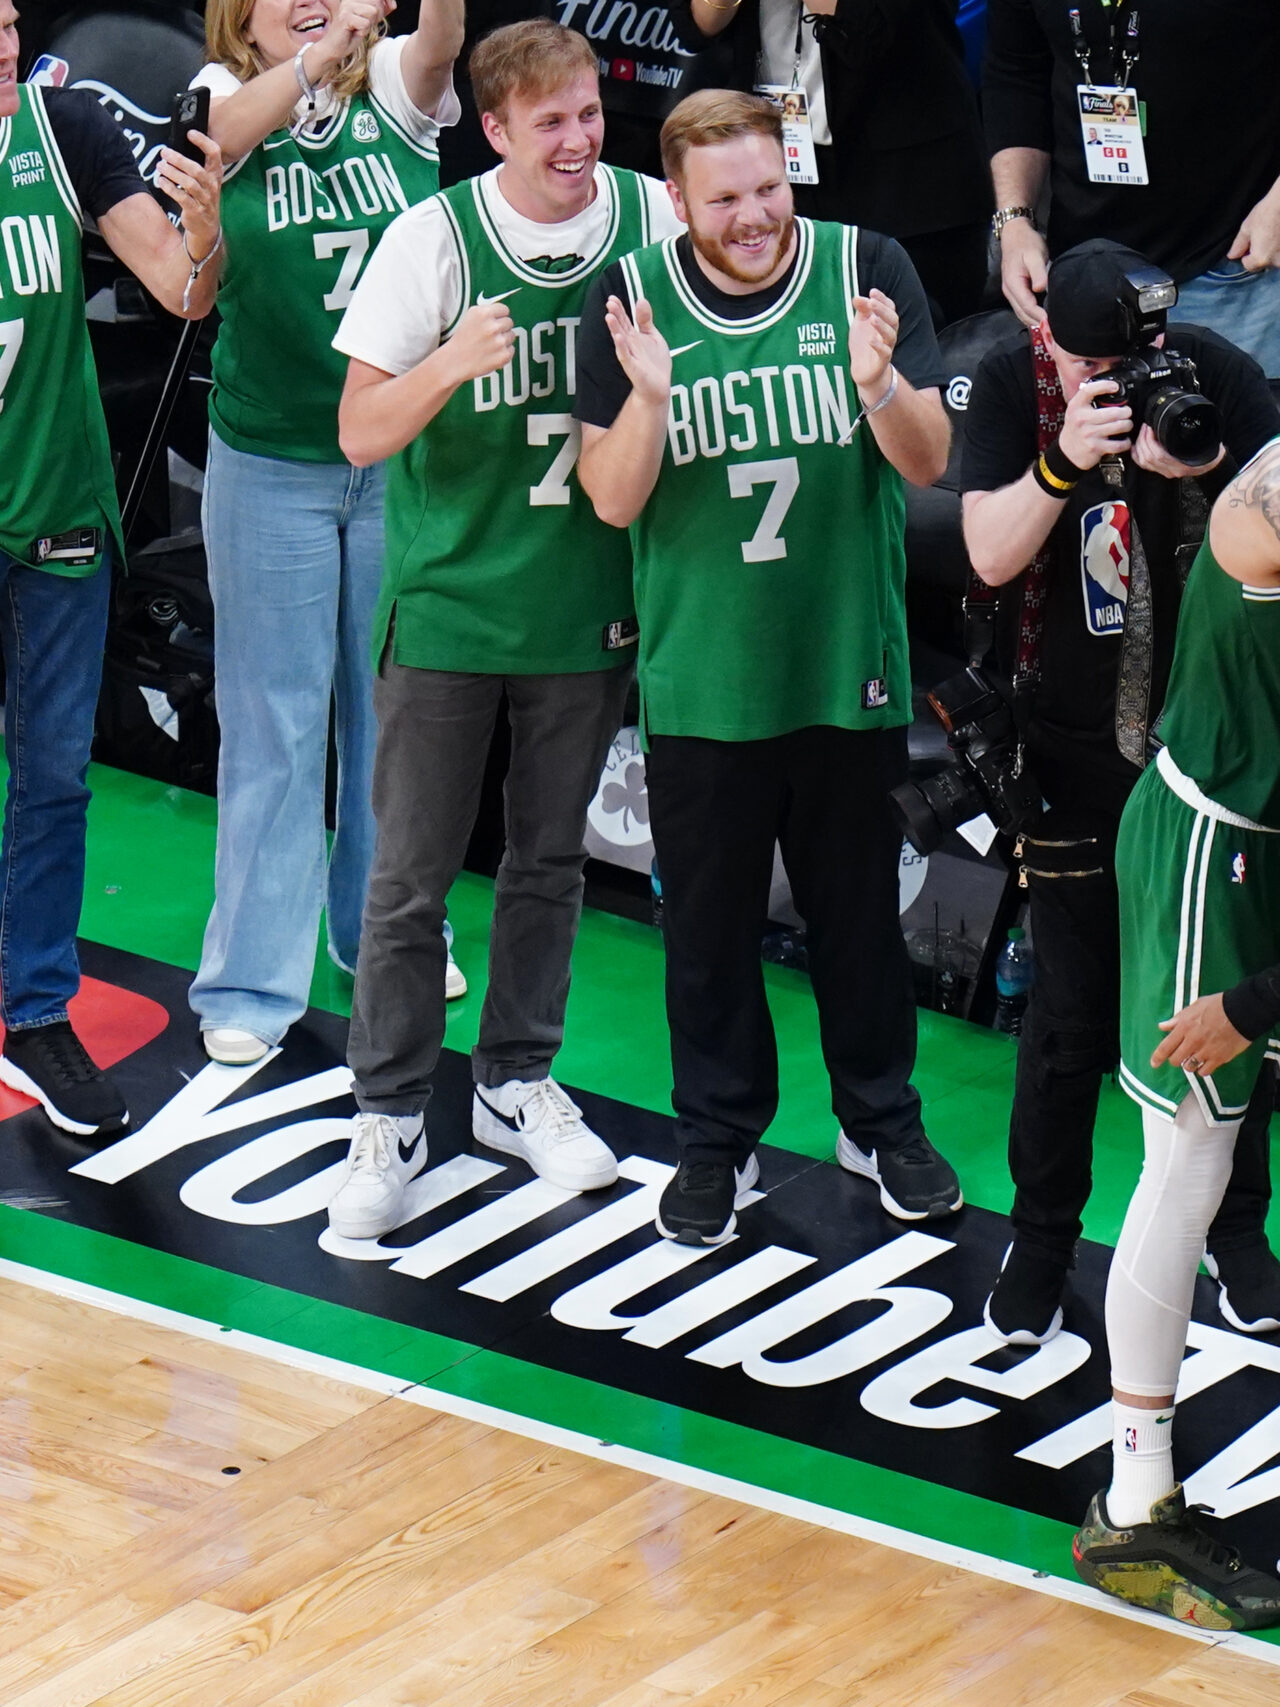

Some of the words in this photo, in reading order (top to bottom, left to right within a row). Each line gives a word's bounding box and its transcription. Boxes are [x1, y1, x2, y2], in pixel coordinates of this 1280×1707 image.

[8, 151, 44, 174] VISTA
[12, 168, 45, 188] PRINT
[265, 153, 409, 232] BOSTON
[0, 214, 62, 298] ON
[313, 228, 370, 311] 7
[474, 316, 582, 412] BOST
[797, 323, 836, 342] VISTA
[798, 341, 836, 357] PRINT
[1150, 368, 1172, 380] Nikon
[667, 364, 853, 466] BOSTON
[527, 413, 582, 506] 7
[727, 456, 800, 563] 7
[1096, 603, 1124, 628] NBA
